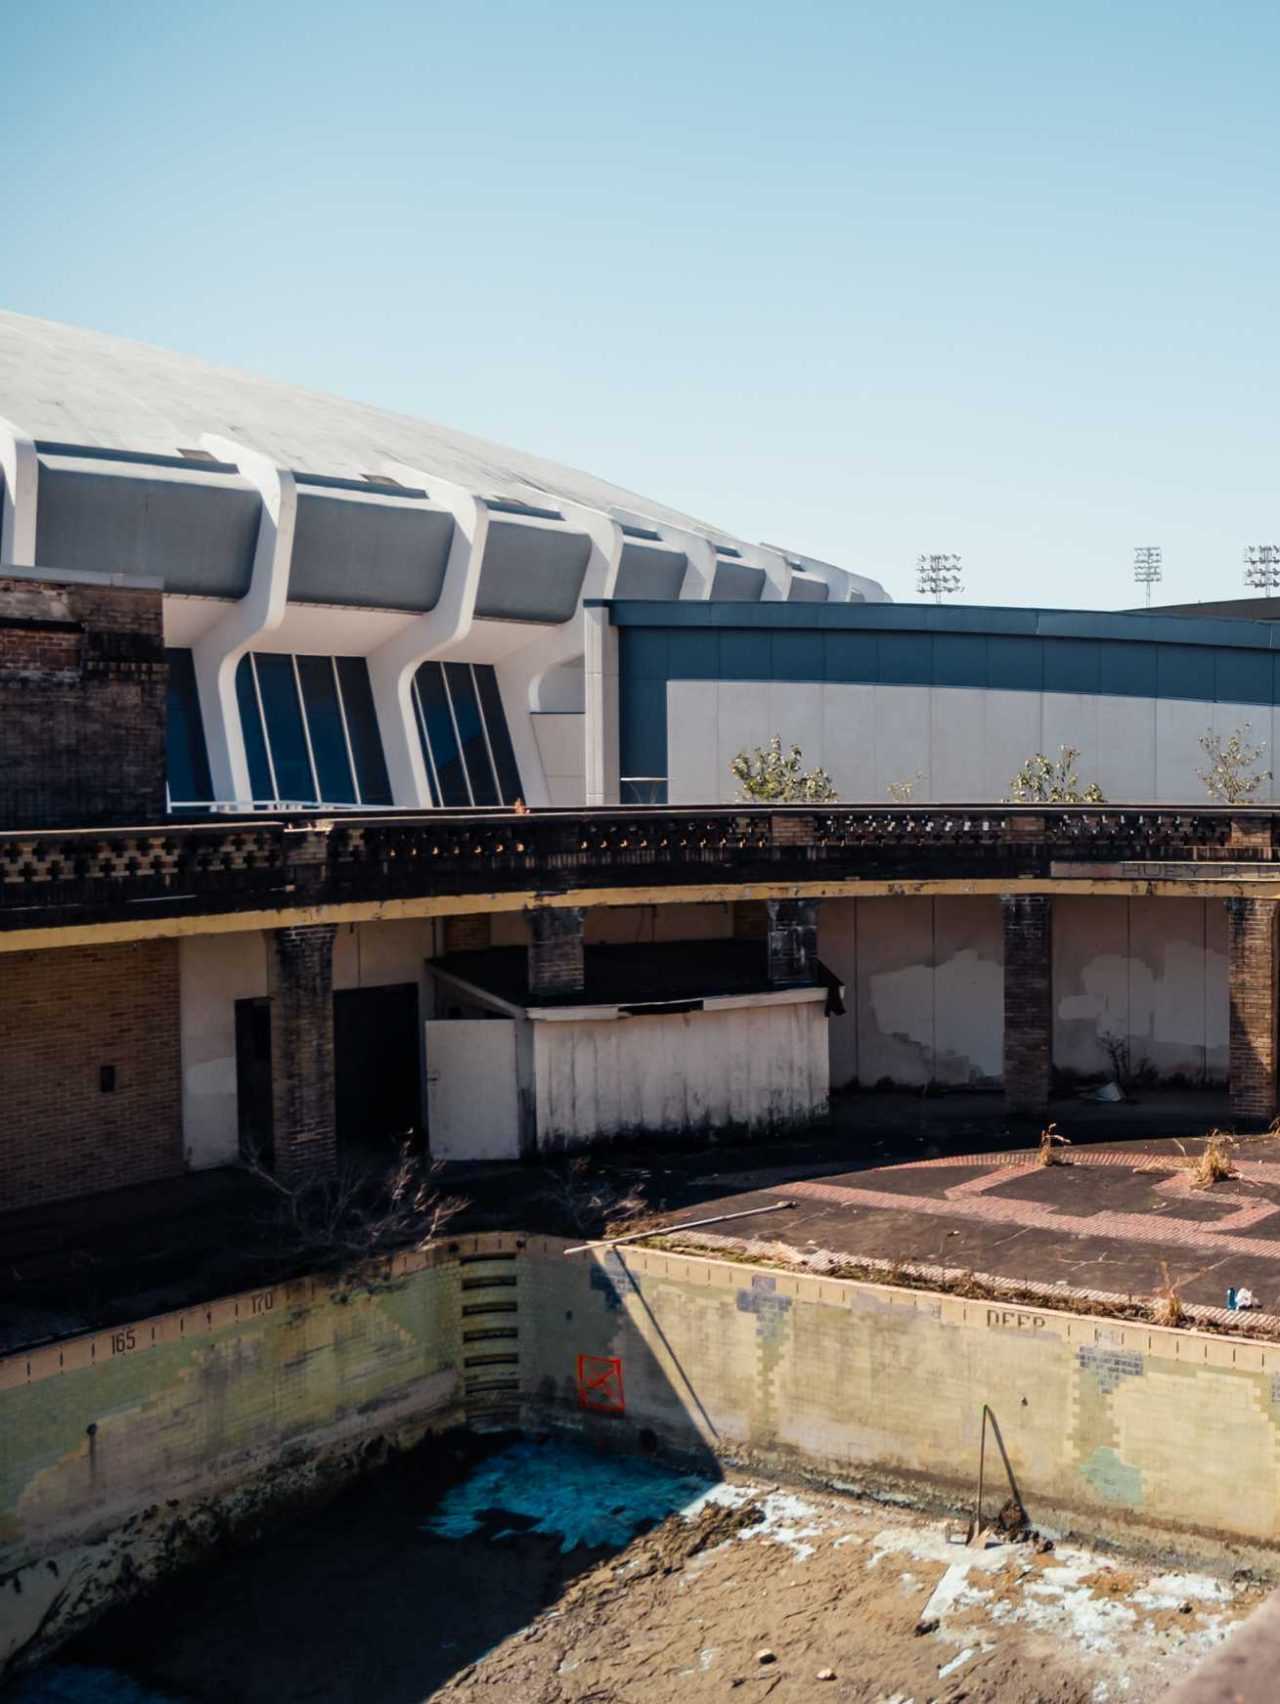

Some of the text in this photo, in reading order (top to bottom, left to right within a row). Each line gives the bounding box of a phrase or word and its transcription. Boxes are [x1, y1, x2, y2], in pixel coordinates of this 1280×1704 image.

[1121, 864, 1201, 877] HUEY
[251, 1291, 273, 1314] 170
[111, 1328, 136, 1355] 165
